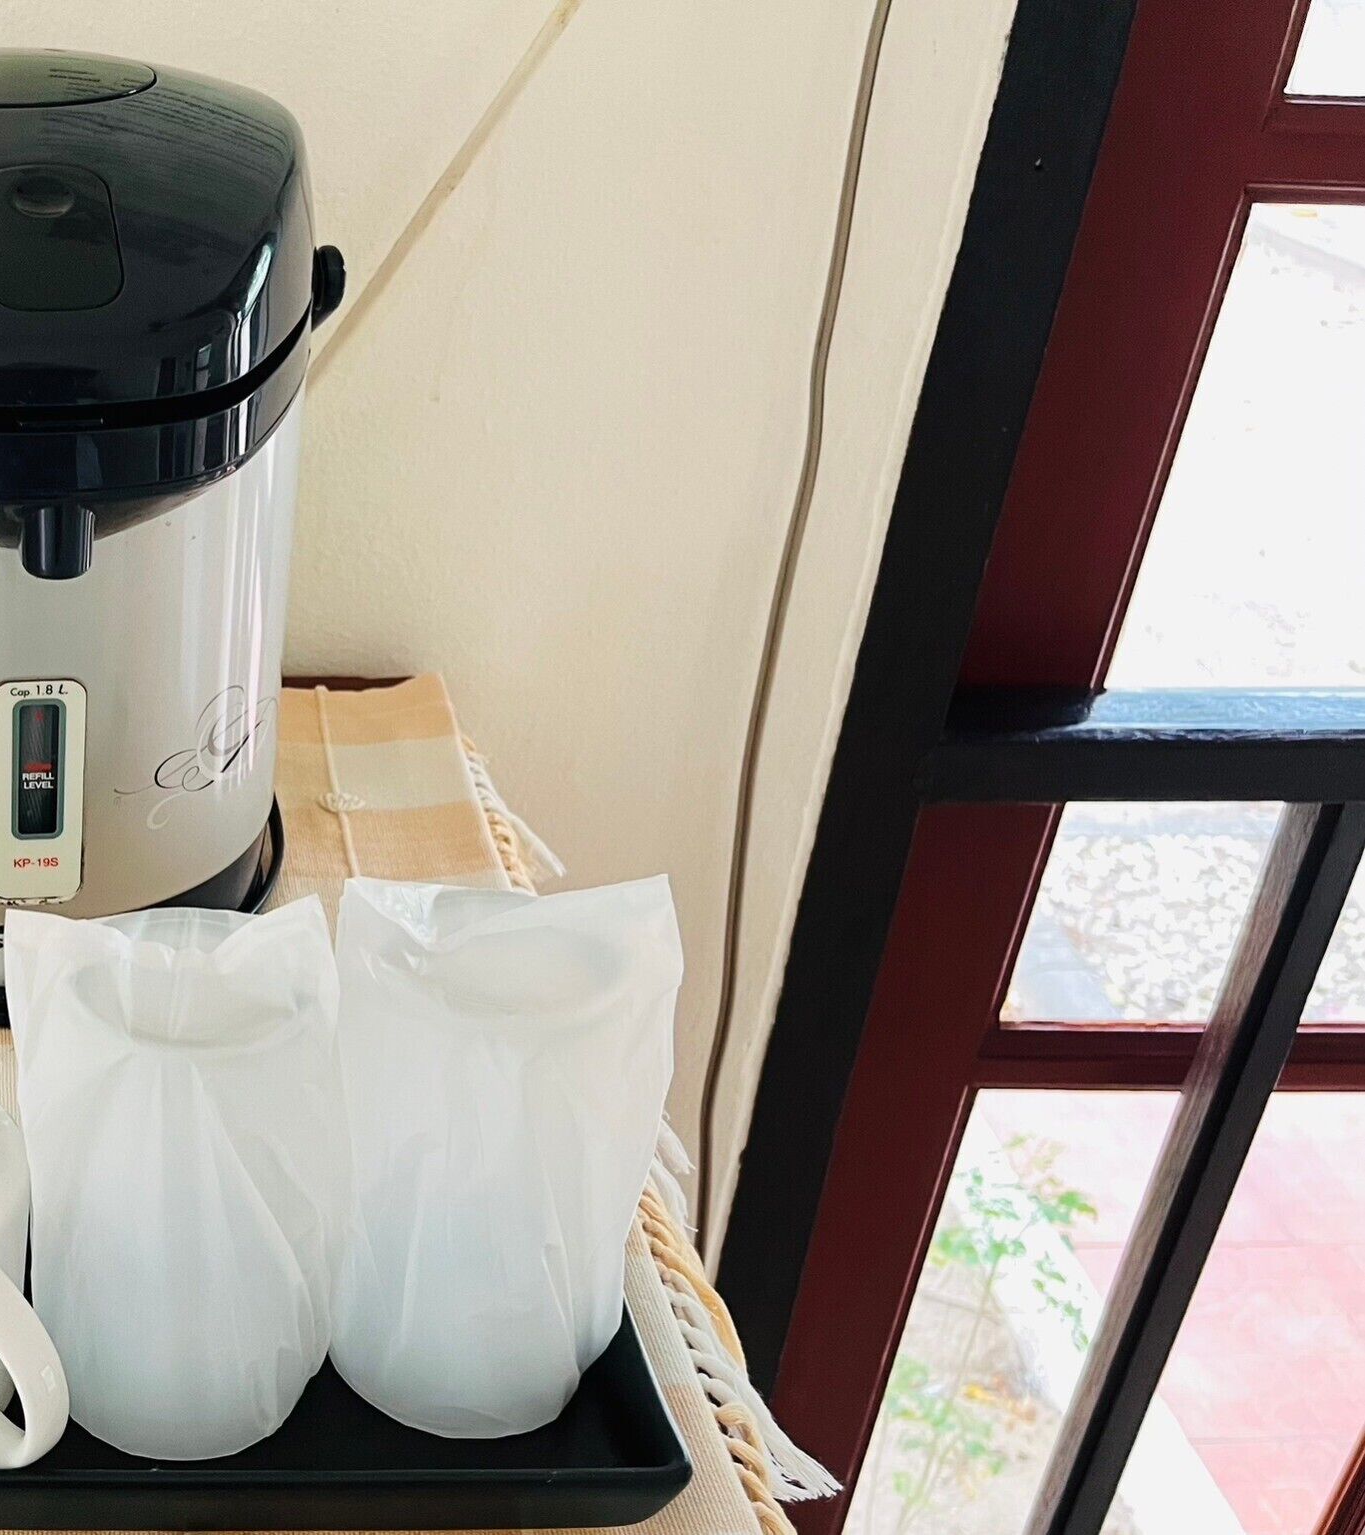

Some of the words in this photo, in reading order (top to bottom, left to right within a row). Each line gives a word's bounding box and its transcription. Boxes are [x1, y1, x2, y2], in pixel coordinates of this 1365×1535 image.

[22, 772, 55, 781] REFILL
[23, 781, 54, 790] LEVEL
[13, 857, 59, 868] KP-19S
